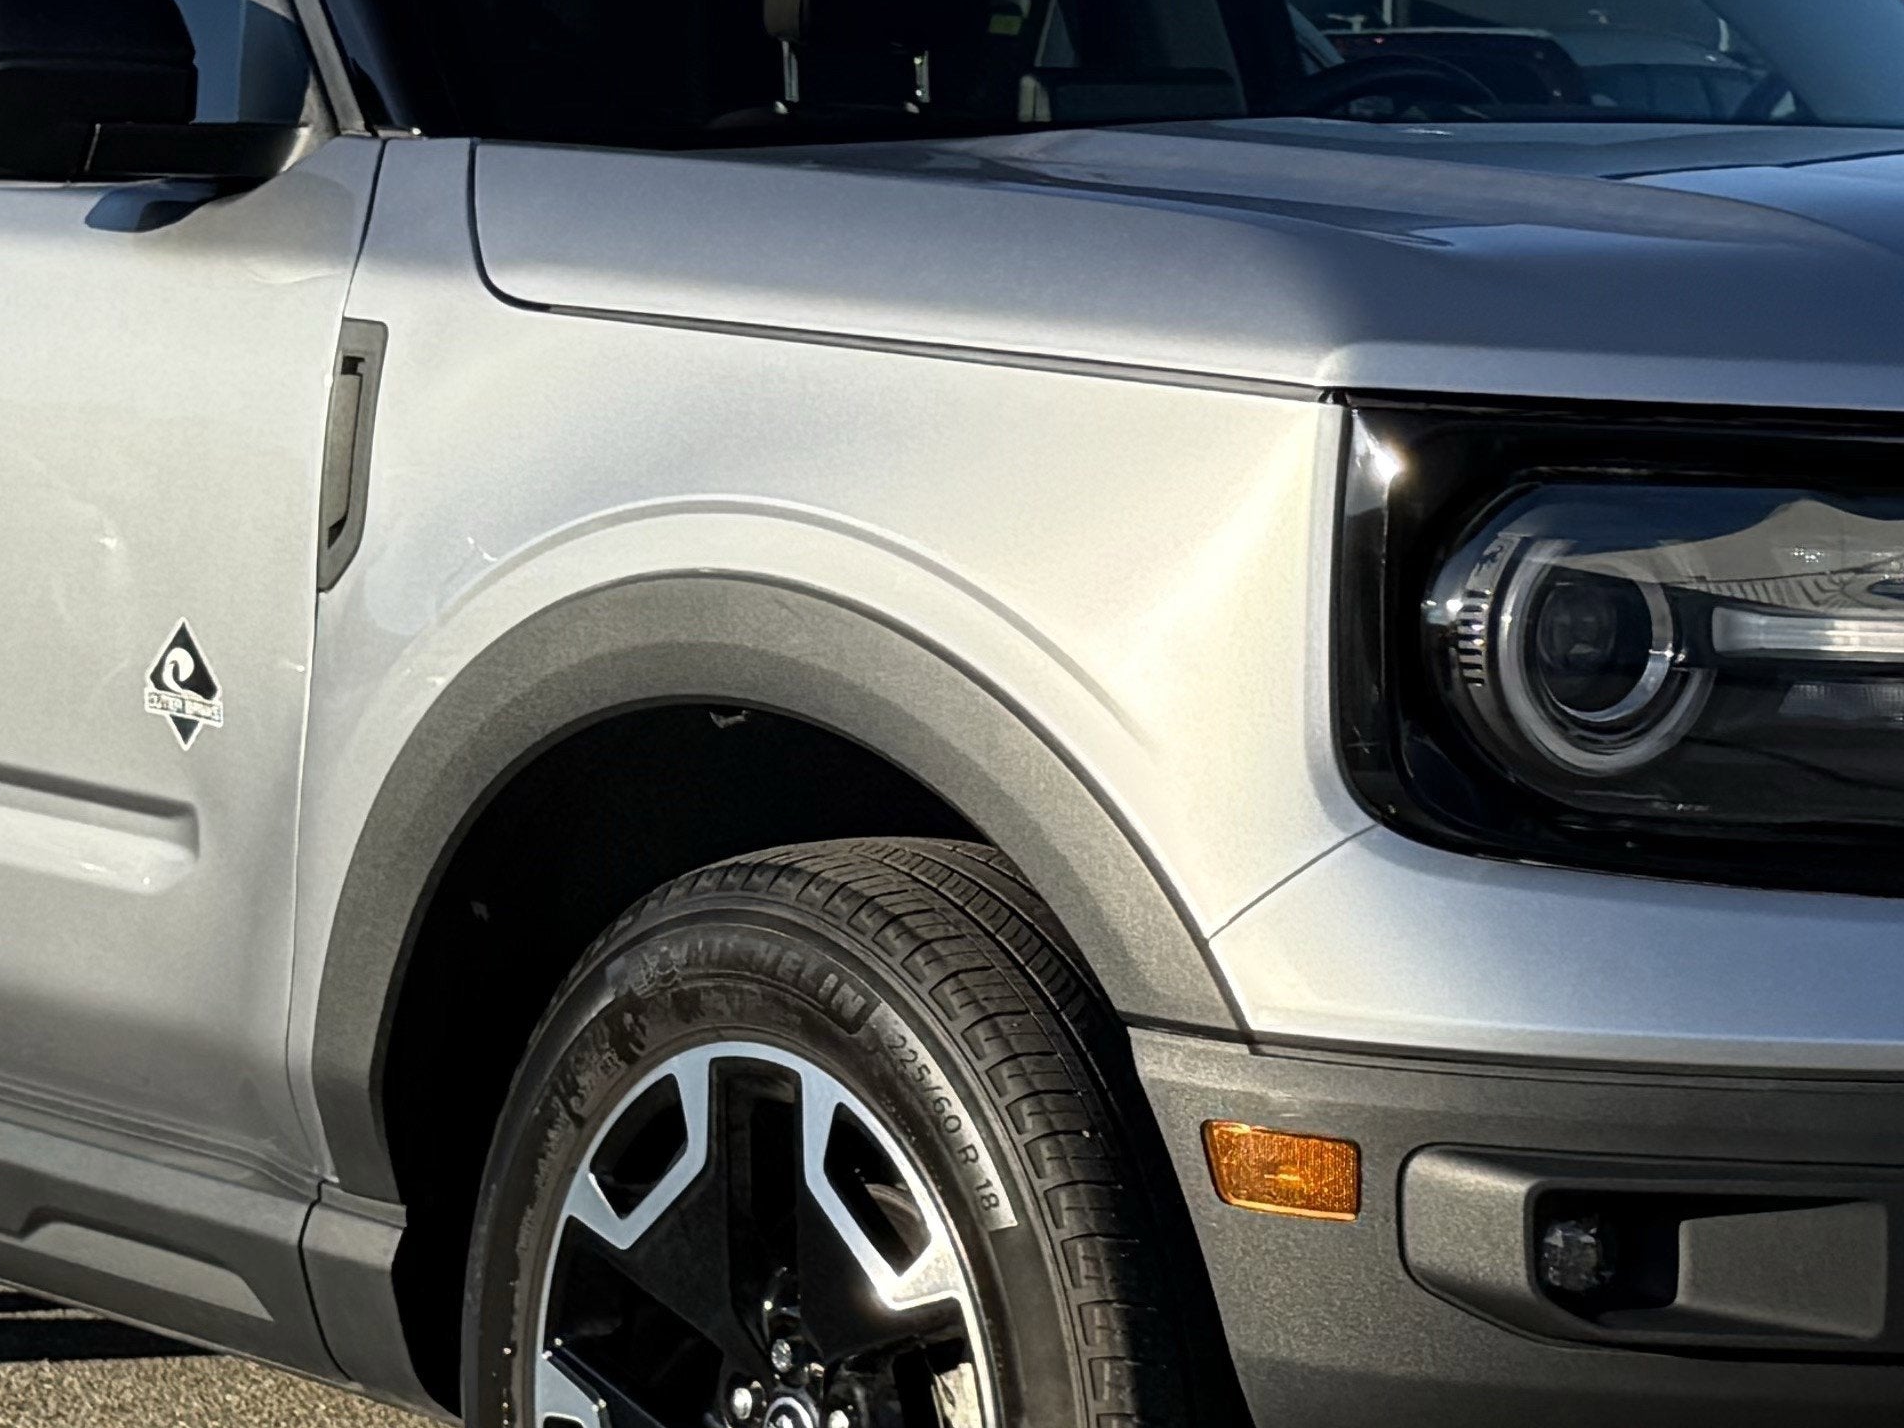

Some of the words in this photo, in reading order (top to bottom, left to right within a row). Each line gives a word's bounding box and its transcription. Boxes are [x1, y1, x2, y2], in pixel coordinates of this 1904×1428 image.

[888, 1034, 962, 1134] 225/60
[957, 1144, 979, 1166] R
[975, 1178, 1000, 1211] 18
